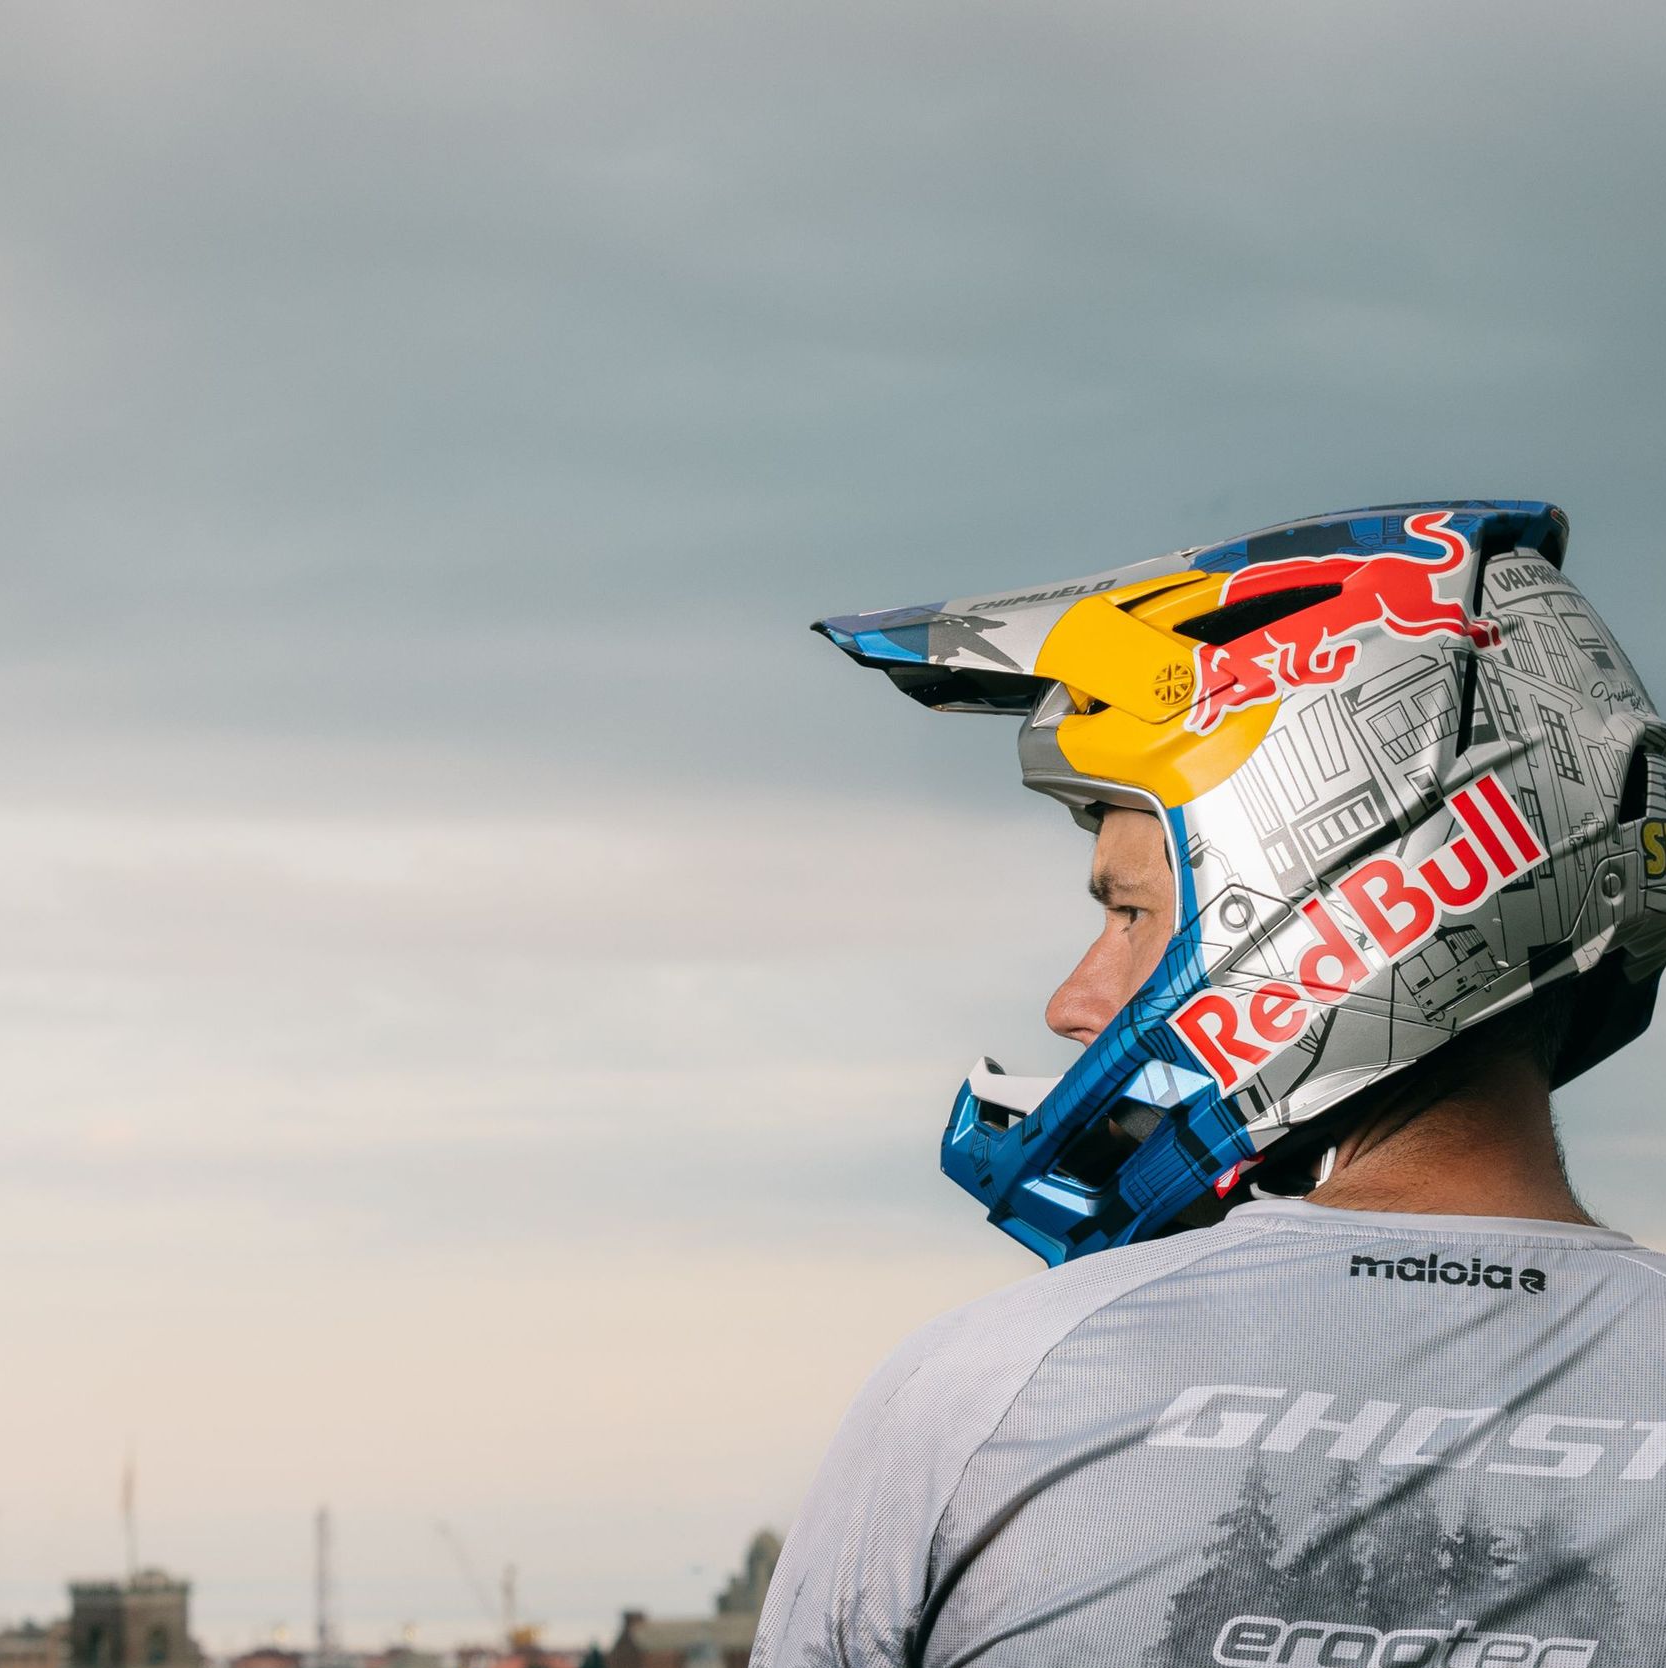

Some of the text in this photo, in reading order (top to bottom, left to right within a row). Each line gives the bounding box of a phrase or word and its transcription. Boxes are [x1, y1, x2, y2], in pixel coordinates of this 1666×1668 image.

[1176, 774, 1542, 1090] Red Bull
[1350, 1253, 1513, 1290] maloja
